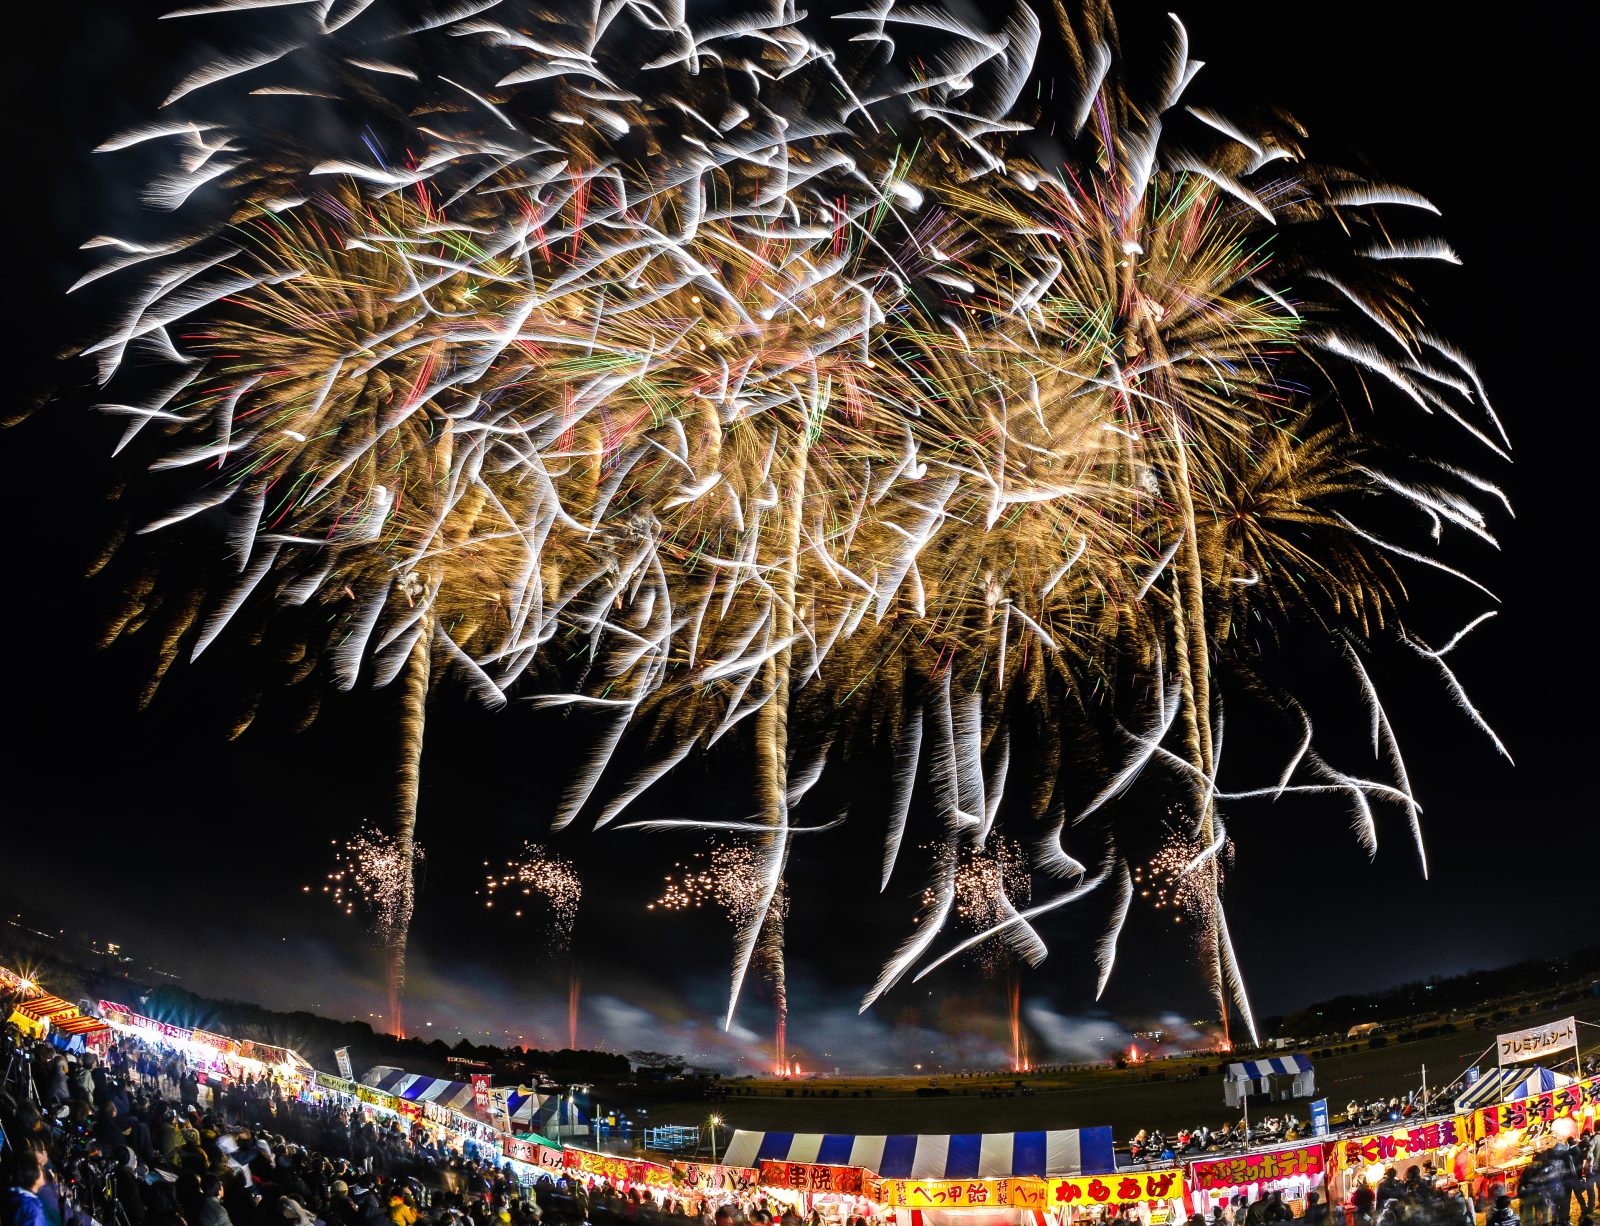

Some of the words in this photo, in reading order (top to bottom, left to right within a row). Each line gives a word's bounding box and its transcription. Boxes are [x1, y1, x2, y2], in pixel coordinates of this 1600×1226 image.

[1501, 1026, 1573, 1055] プレミアムシート
[577, 1152, 628, 1180] たこやき
[687, 1165, 756, 1192] じゃがバター
[789, 1166, 832, 1192] 串焼
[895, 1181, 907, 1206] 特製
[913, 1182, 989, 1205] べっ甲飴
[997, 1181, 1009, 1206] 特製
[1056, 1172, 1177, 1203] からあげ
